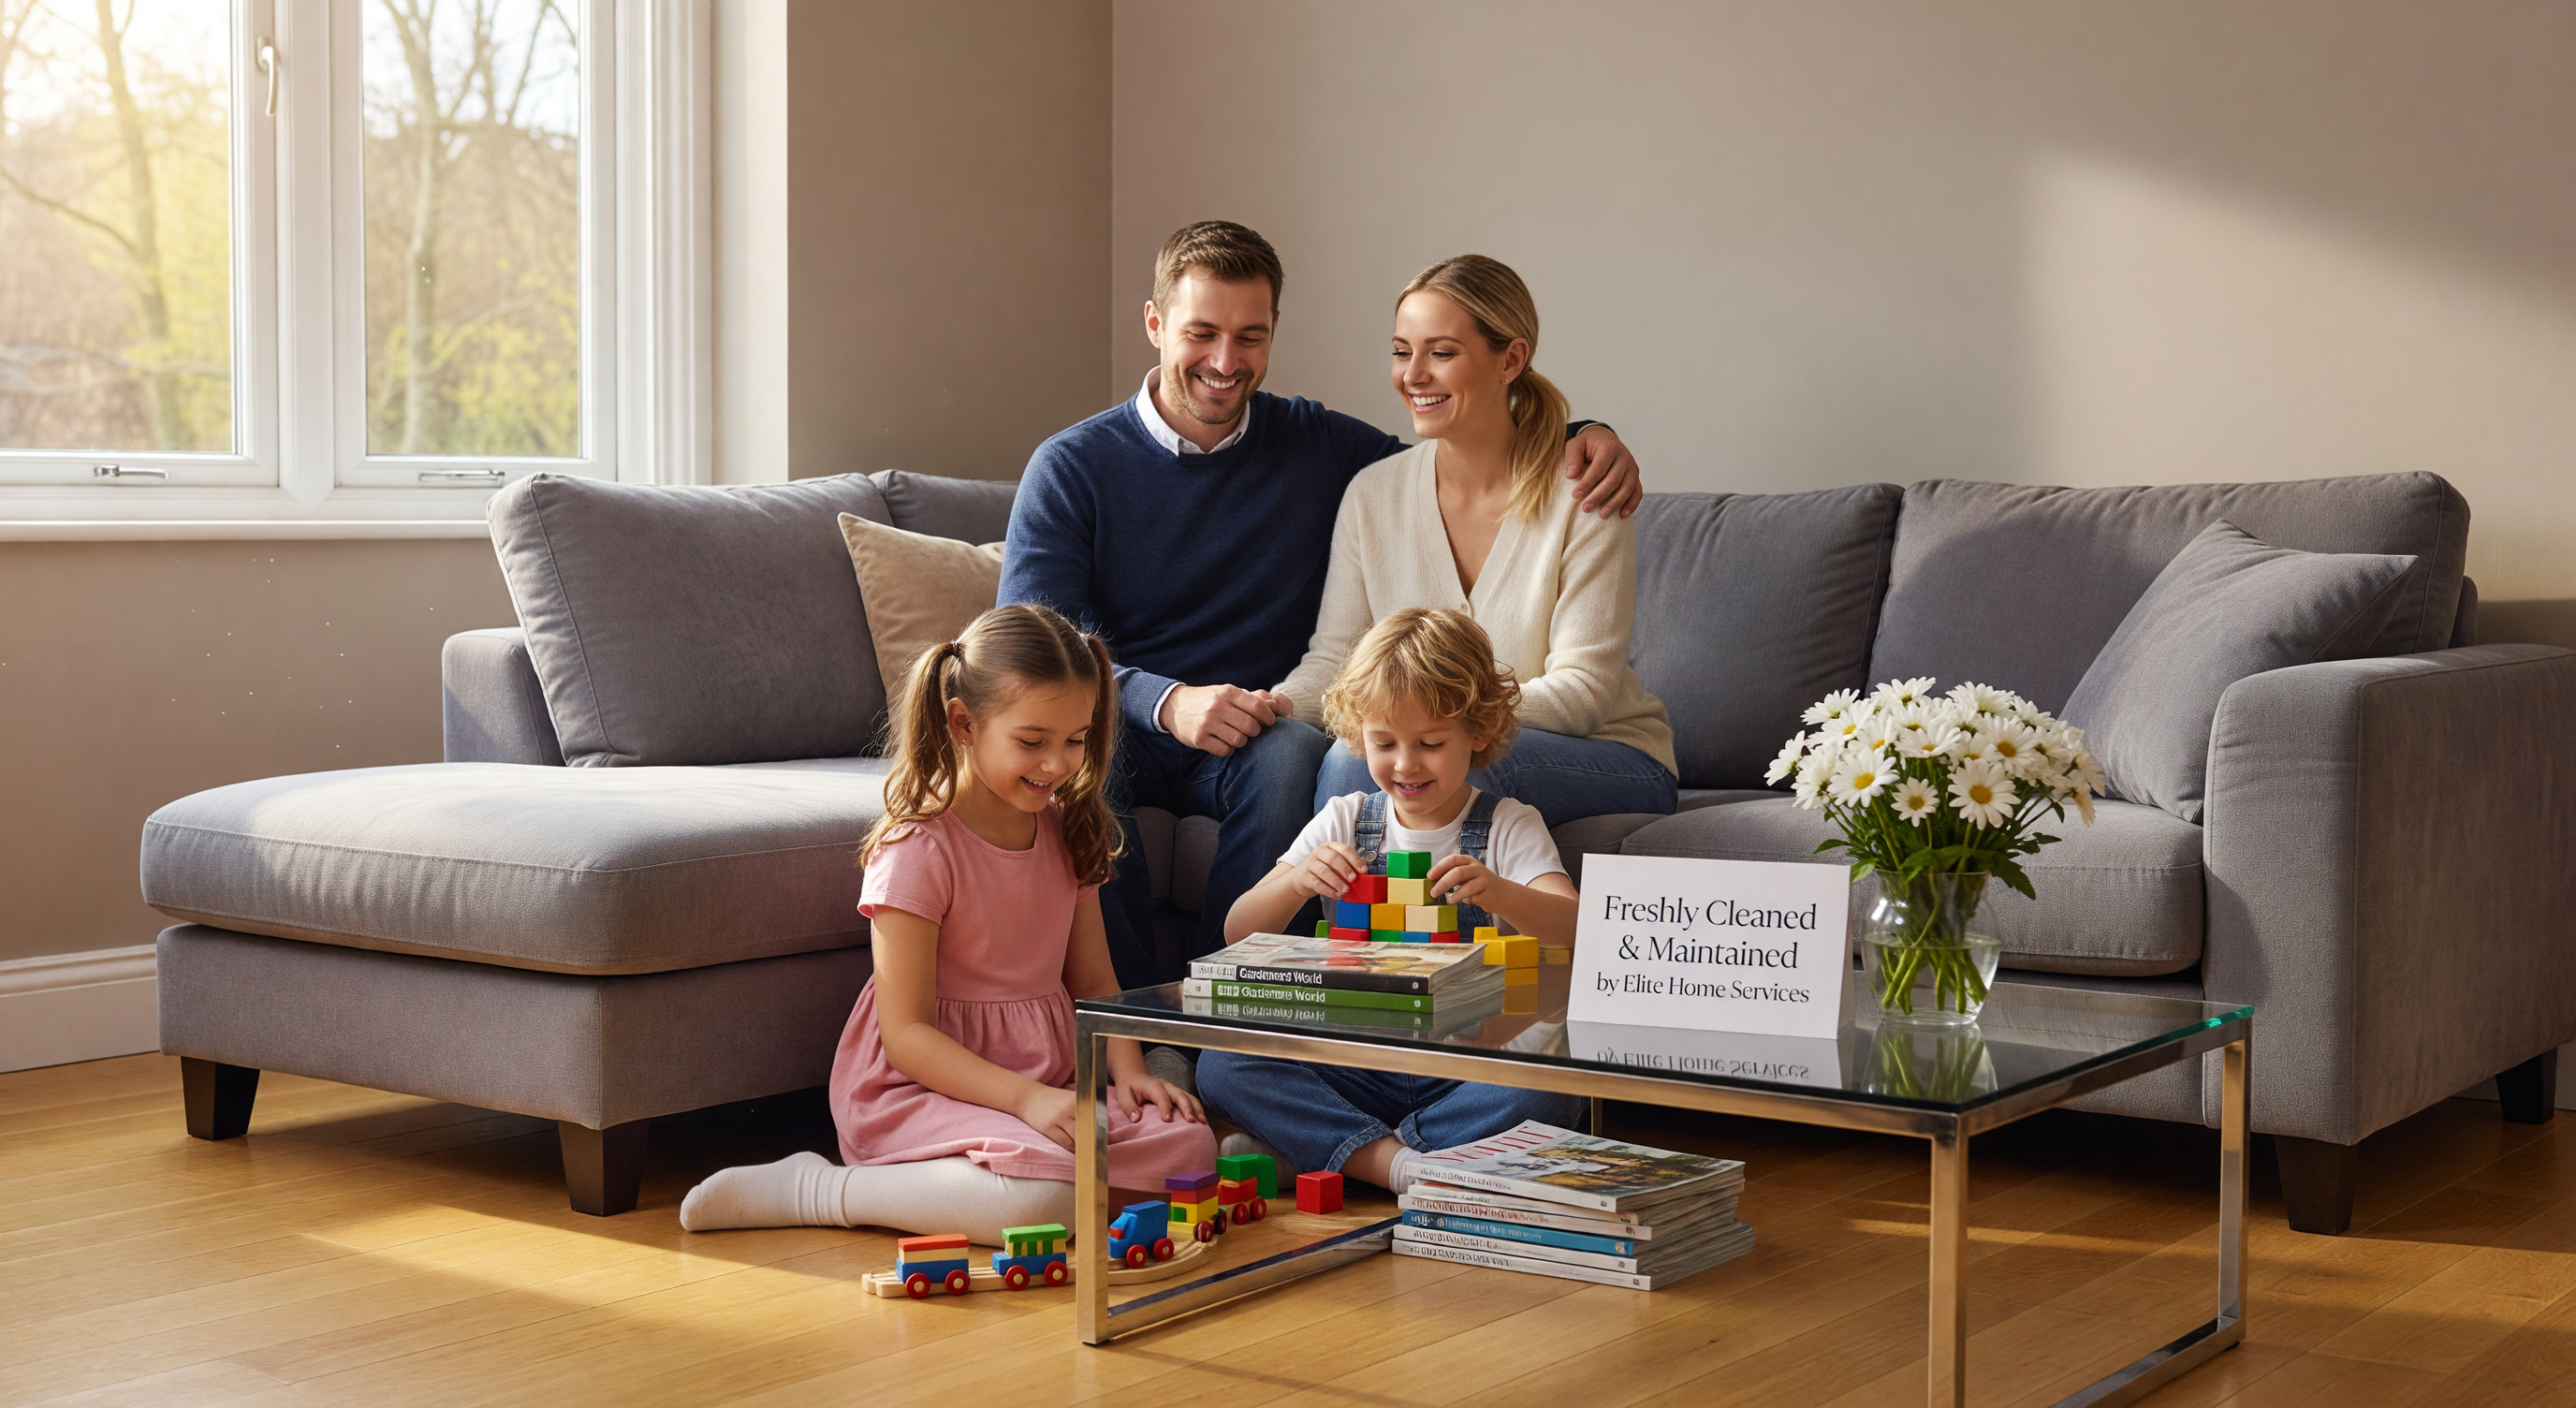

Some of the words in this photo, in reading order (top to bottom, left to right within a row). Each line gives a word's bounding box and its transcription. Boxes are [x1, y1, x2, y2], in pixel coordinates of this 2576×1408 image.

[1603, 895, 1700, 931] Freshly
[1705, 899, 1817, 931] Cleaned
[1618, 934, 1640, 961] &
[1647, 936, 1798, 969] Maintained
[1293, 971, 1323, 985] World
[1596, 972, 1619, 997] by
[1623, 974, 1663, 995] Elite
[1669, 976, 1726, 999] Home
[1730, 980, 1809, 1004] Services
[1295, 989, 1325, 1003] World
